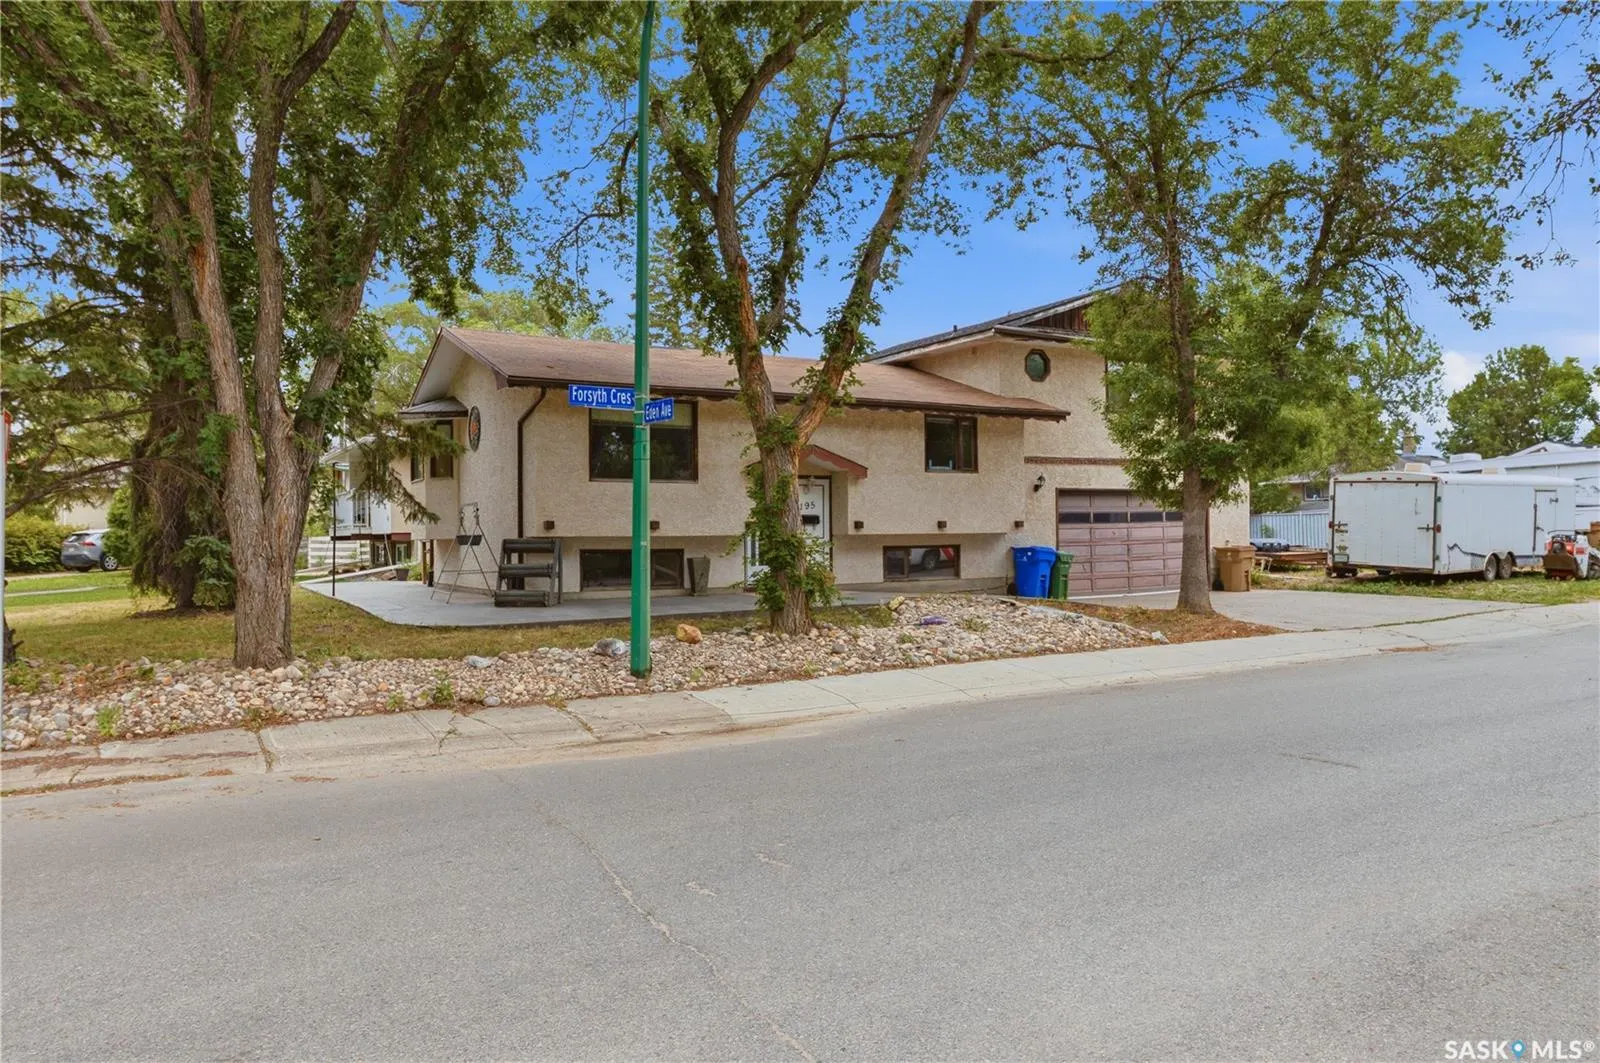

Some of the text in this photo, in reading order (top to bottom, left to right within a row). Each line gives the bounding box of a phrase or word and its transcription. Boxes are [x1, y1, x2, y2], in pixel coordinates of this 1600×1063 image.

[572, 386, 632, 406] Forsyth Cres
[645, 401, 672, 420] Eden Ave
